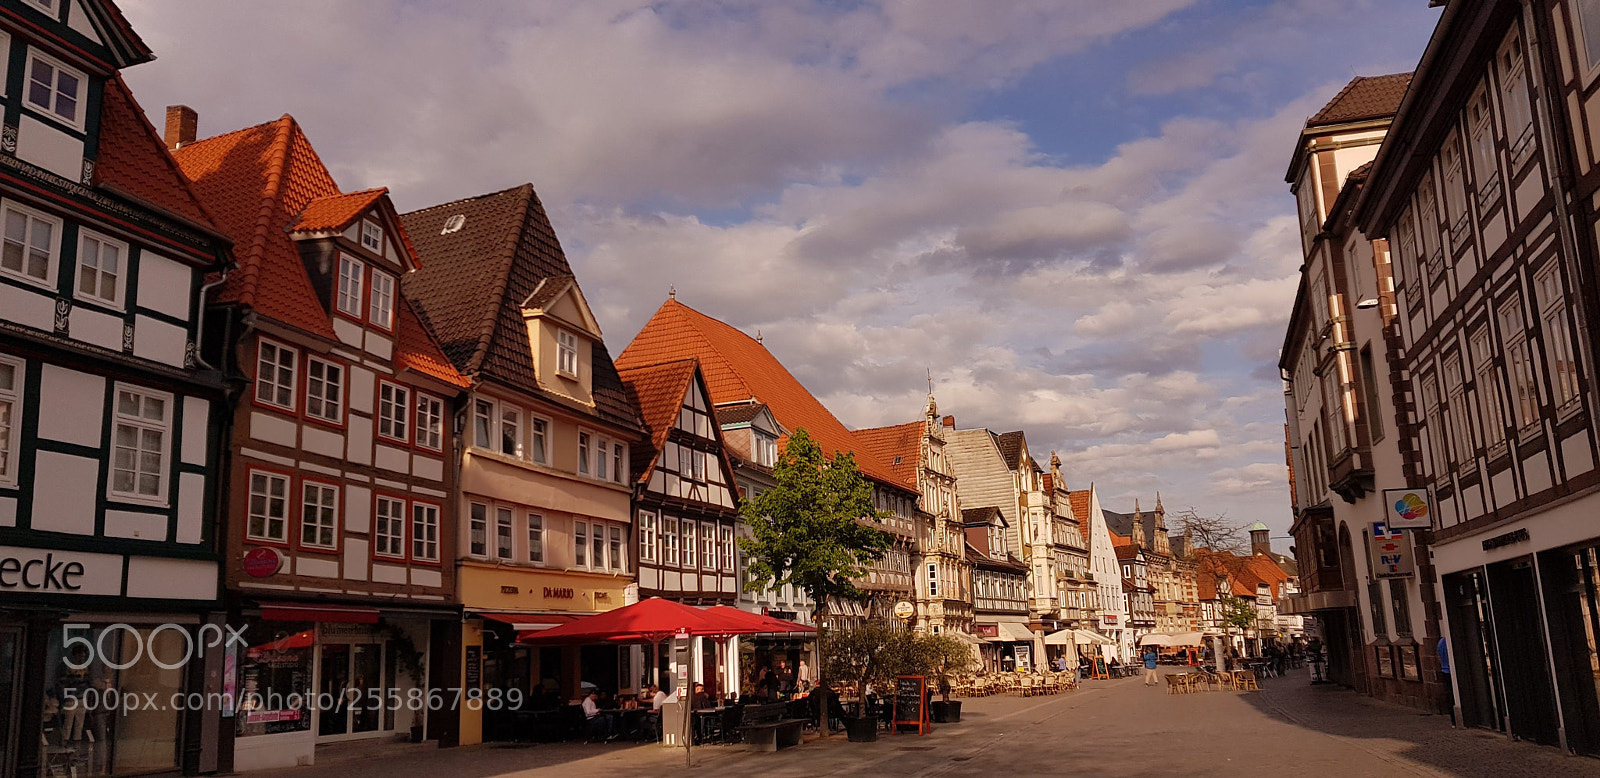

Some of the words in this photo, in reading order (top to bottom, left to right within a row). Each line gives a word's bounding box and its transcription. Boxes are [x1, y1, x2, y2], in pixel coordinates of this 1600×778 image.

[0, 553, 85, 590] ecke
[543, 587, 553, 598] DA
[553, 588, 574, 599] MARIO
